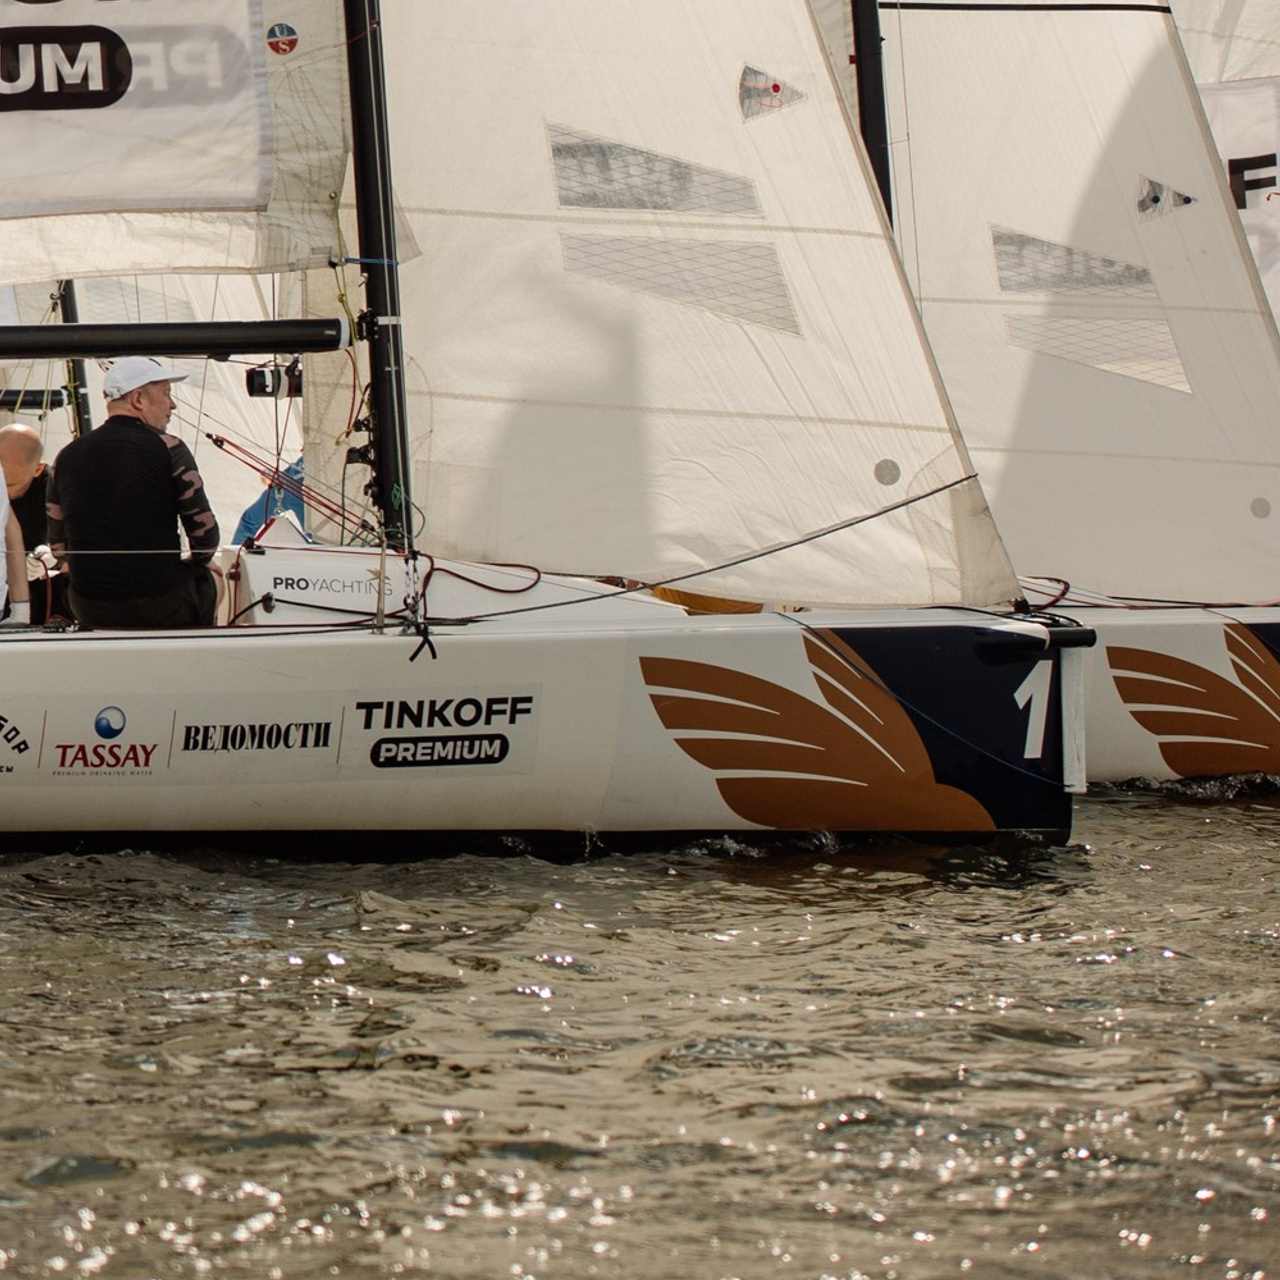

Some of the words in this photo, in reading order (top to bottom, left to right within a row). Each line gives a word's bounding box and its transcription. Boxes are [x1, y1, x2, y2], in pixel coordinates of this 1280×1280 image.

[355, 696, 533, 730] TINKOFF
[1013, 659, 1053, 759] 1
[181, 721, 332, 753] ВЕДОМОСТИ
[378, 738, 502, 763] PREMIUM
[54, 744, 159, 768] TASSAY
